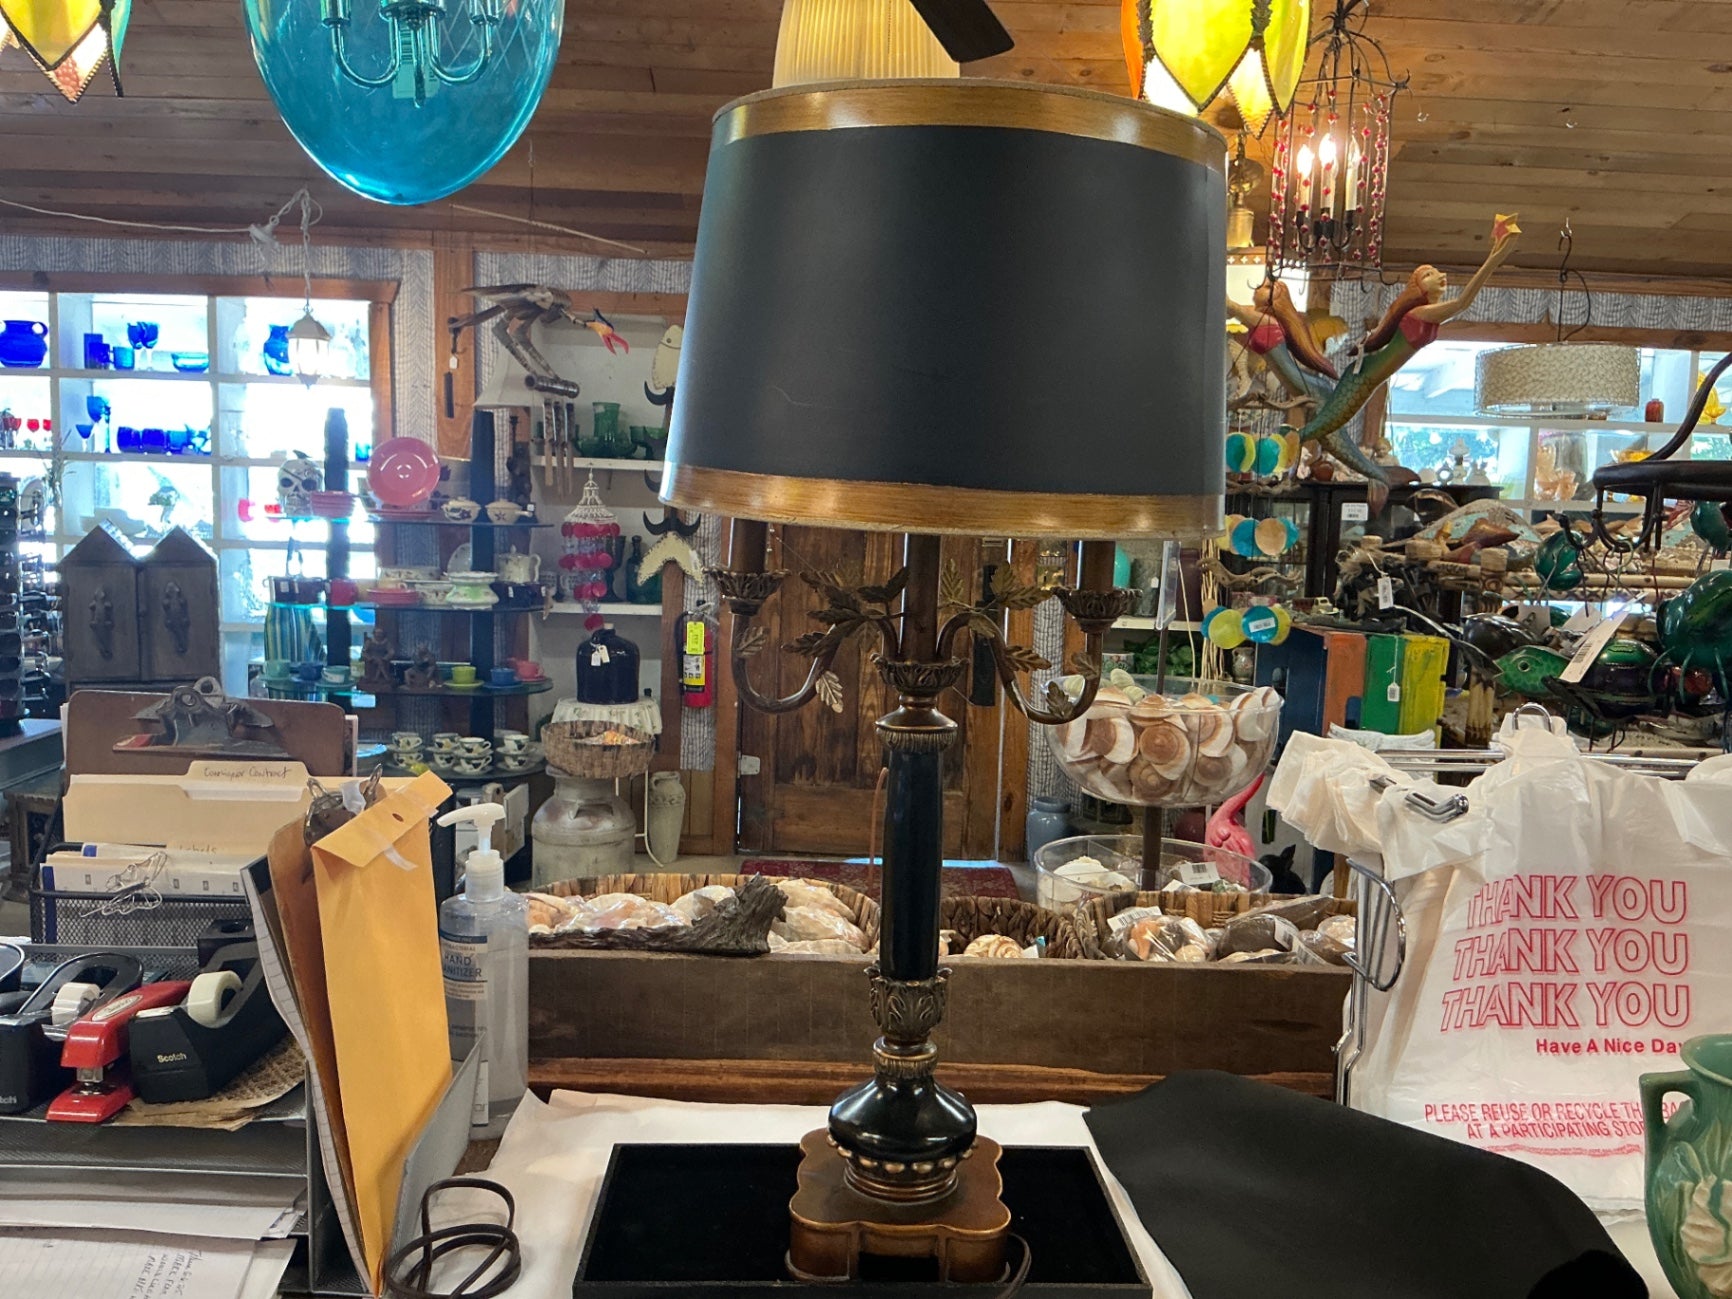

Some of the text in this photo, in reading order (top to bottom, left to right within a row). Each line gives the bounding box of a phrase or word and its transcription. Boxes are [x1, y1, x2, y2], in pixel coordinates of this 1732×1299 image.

[1467, 874, 1688, 930] THANK YOU
[445, 953, 472, 966] HAND
[1453, 927, 1689, 982] THANK YOU
[1440, 980, 1691, 1033] THANK YOU
[1536, 1038, 1682, 1054] Have A Nice Da
[156, 1052, 187, 1064] Scotch
[1424, 1103, 1479, 1123] PLEASE
[1481, 1103, 1528, 1121] REUSE
[1532, 1102, 1556, 1120] OR
[1557, 1102, 1620, 1120] RECYCLE
[1620, 1101, 1643, 1119] TH
[1467, 1120, 1645, 1139] AT A PARTICIPATING STO
